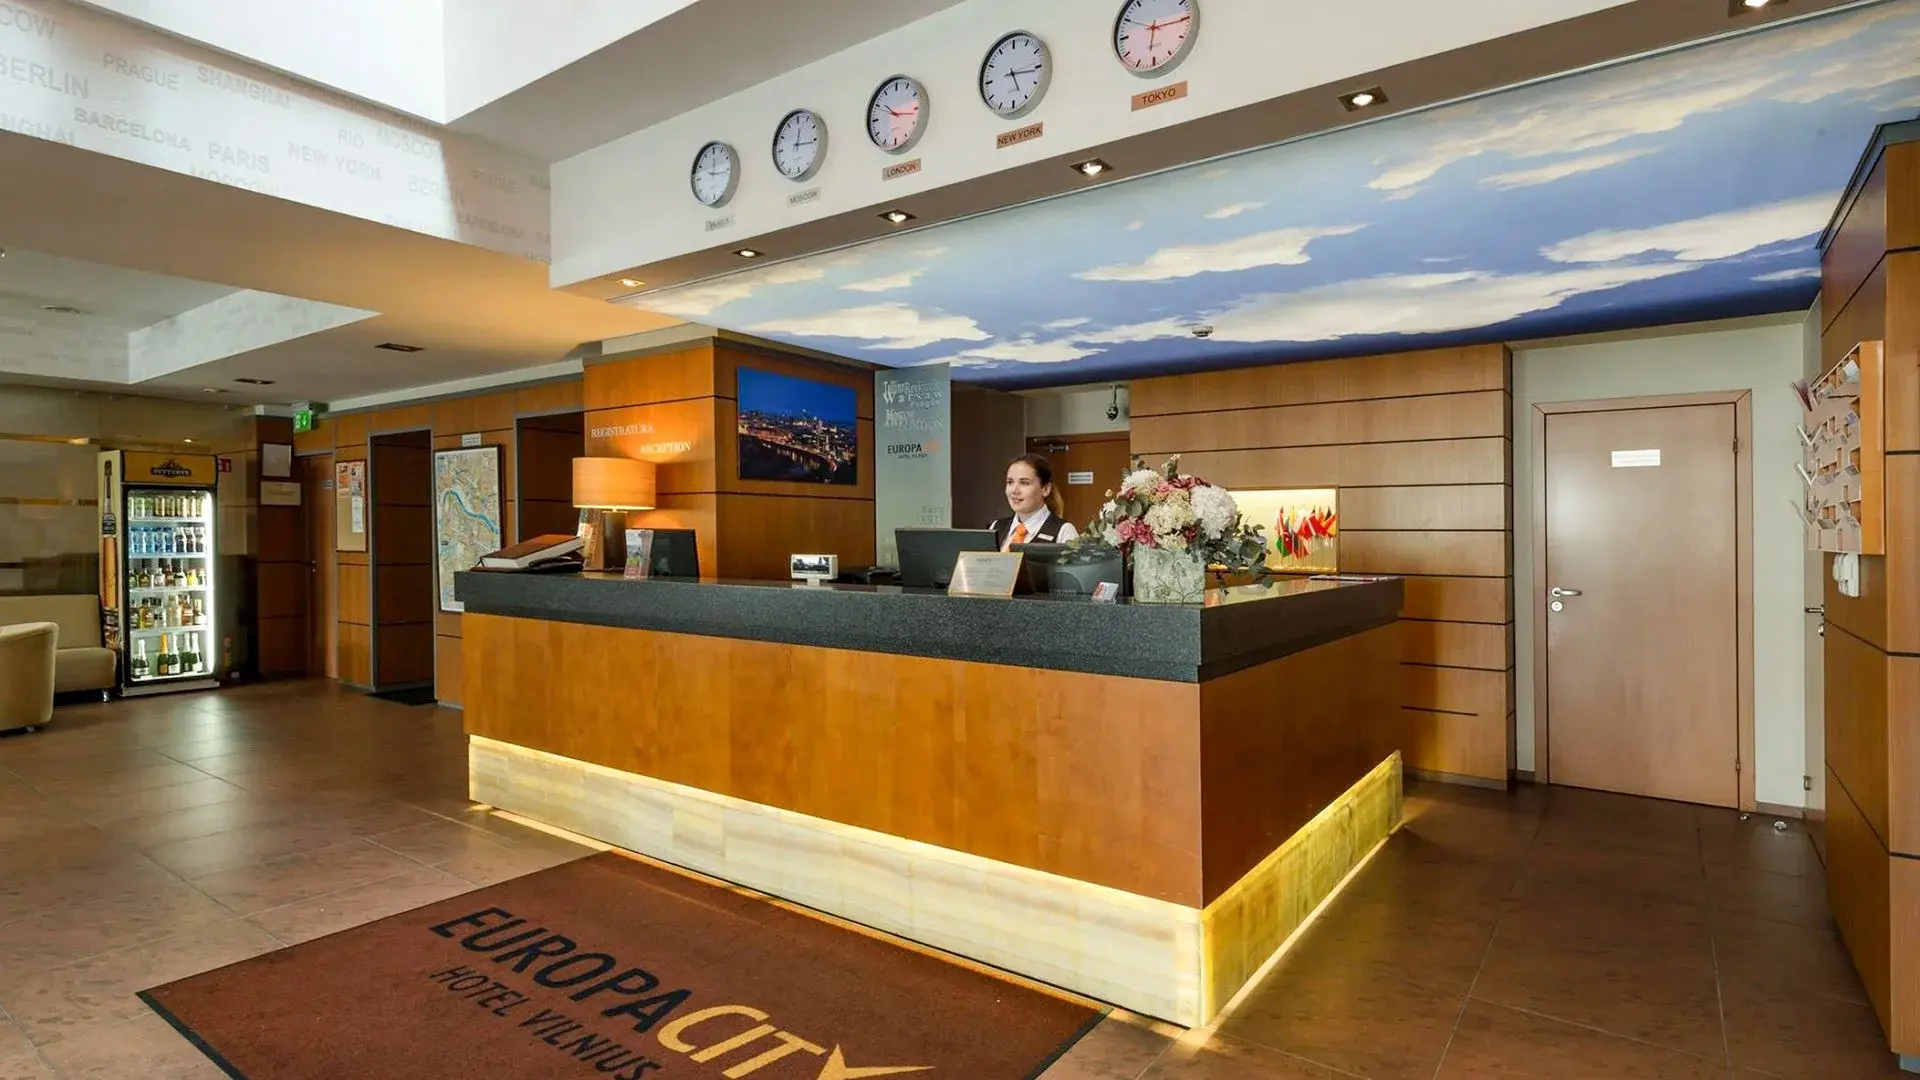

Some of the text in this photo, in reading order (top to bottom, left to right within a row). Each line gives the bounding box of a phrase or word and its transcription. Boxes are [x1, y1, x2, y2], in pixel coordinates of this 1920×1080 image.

[102, 52, 180, 92] PRAGUE
[196, 65, 291, 109] SHANGHAI
[1141, 88, 1176, 105] TOKYO
[73, 106, 192, 152] BARCELONA
[337, 128, 365, 150] RIO
[997, 126, 1042, 147] NEW YORK
[208, 139, 271, 174] PARIS
[287, 141, 382, 182] NEW YORK
[886, 161, 916, 177] LONDON
[429, 965, 662, 1080] HOTEL VILNIUS
